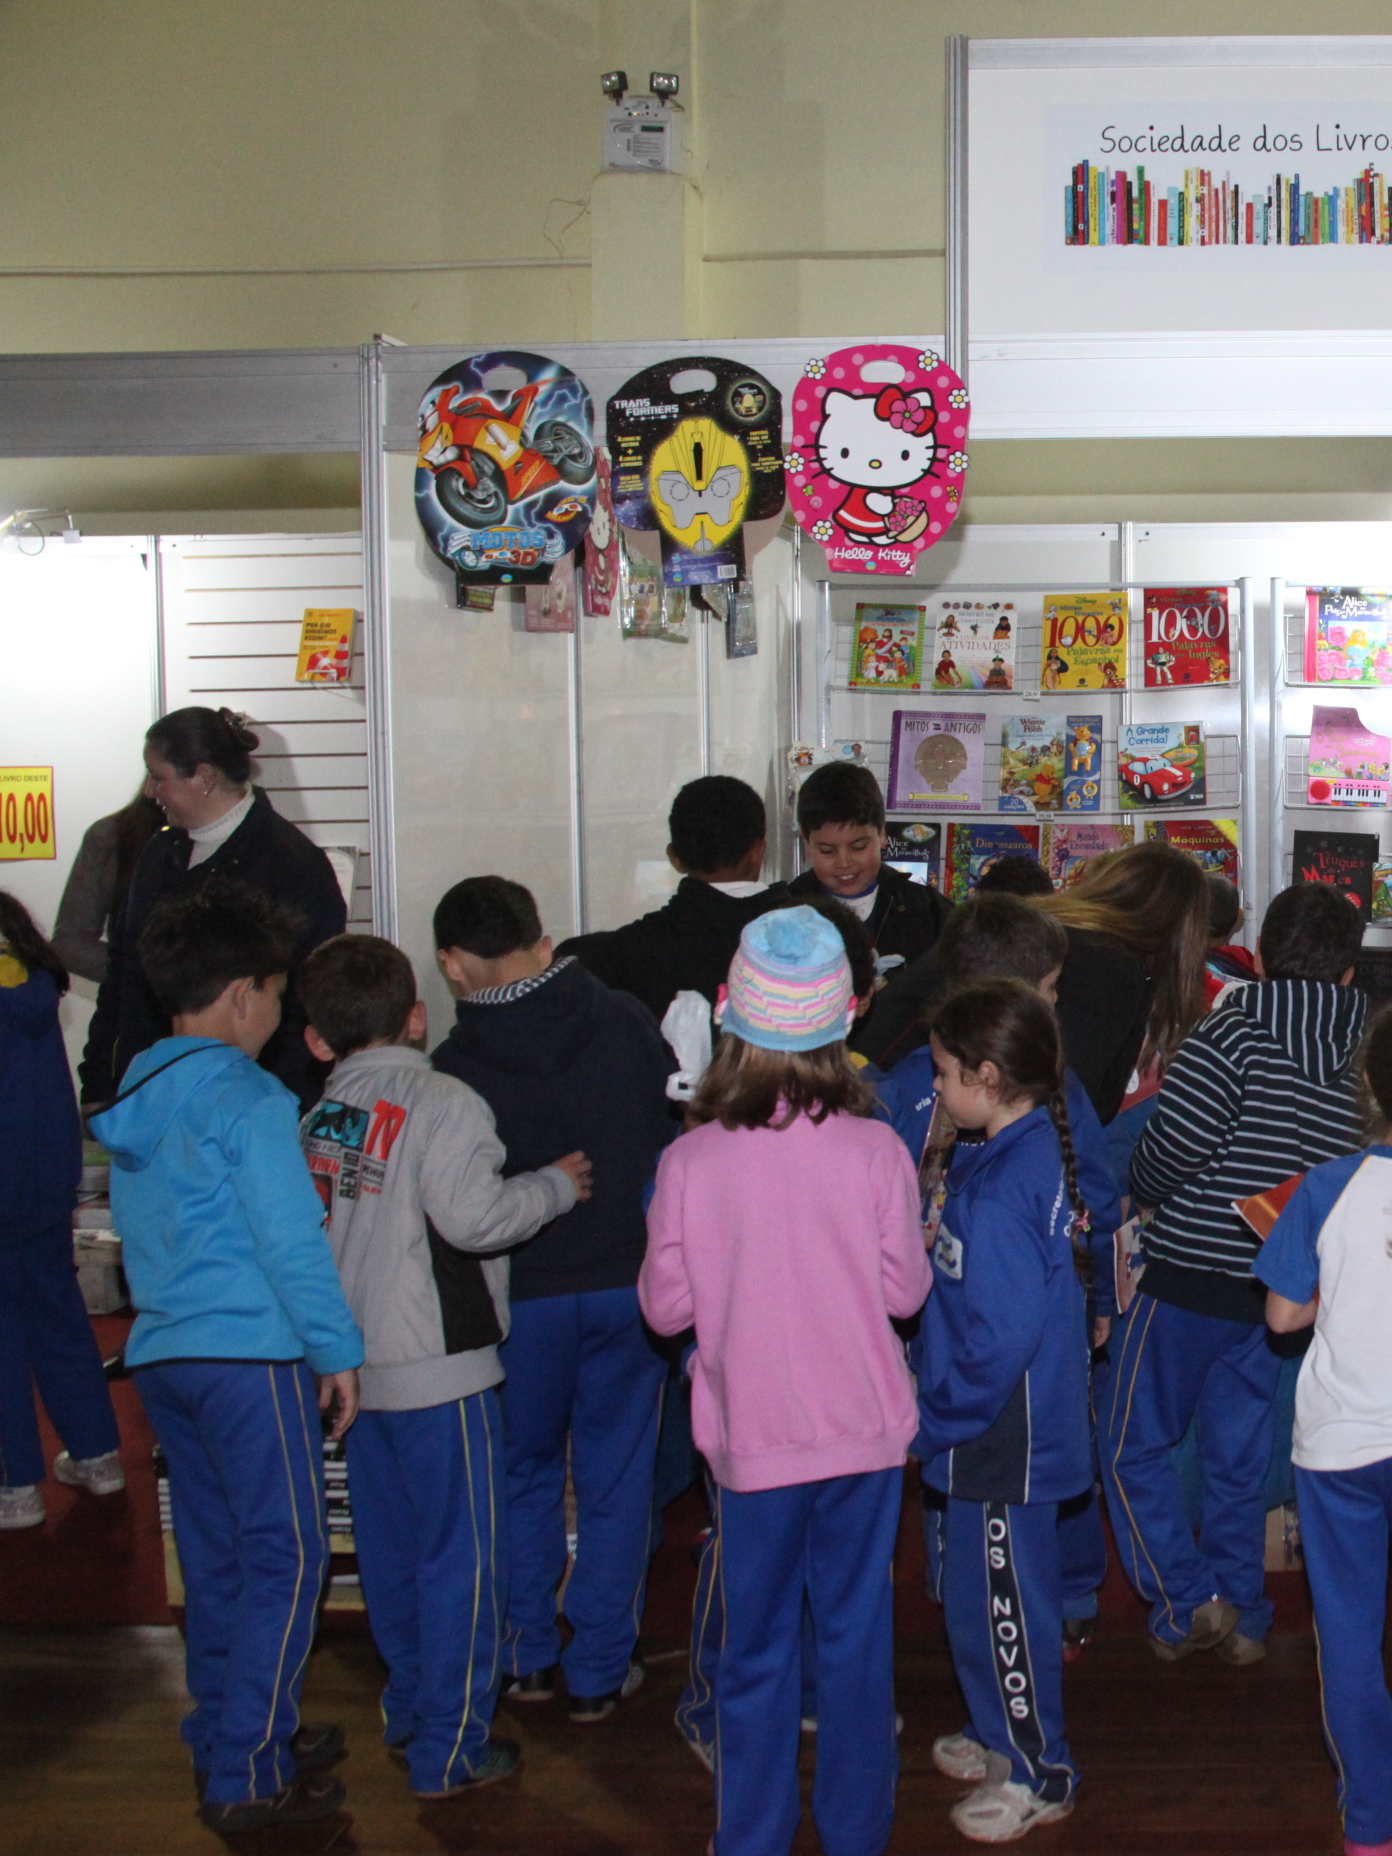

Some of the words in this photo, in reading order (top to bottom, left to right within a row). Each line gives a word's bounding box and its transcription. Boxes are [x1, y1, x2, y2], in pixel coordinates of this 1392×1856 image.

[1101, 124, 1241, 153] Sociedade
[1253, 125, 1303, 152] dos
[614, 398, 650, 409] TRANS
[626, 404, 679, 417] FORMERS
[470, 530, 547, 550] MOTOS
[508, 550, 537, 566] 3D
[834, 547, 873, 560] Hello
[878, 548, 912, 567] Kitty
[1342, 597, 1368, 609] Alice
[1147, 608, 1226, 643] 1000
[1044, 615, 1124, 649] 1000
[938, 640, 1011, 651] ATIVIDADES
[1066, 647, 1111, 656] Palavras
[1171, 640, 1217, 651] Palavras
[1074, 655, 1120, 667] Espanhol
[904, 720, 929, 731] MITOS
[943, 723, 982, 734] ANTIGOS
[1019, 718, 1045, 726] Winnie
[1024, 725, 1043, 733] Pooh
[1126, 726, 1133, 736] A
[1136, 725, 1170, 735] Grande
[1128, 734, 1168, 745] Corrida!
[886, 836, 909, 848] Alice
[1077, 832, 1100, 841] Mundo
[1171, 834, 1225, 845] Máquinas
[1070, 841, 1109, 850] Encantado
[885, 847, 929, 861] Maravilhas
[1312, 852, 1365, 871] Truques
[339, 1167, 359, 1199] BEN
[987, 1517, 1007, 1569] OS
[993, 1595, 1029, 1719] NOVOS
